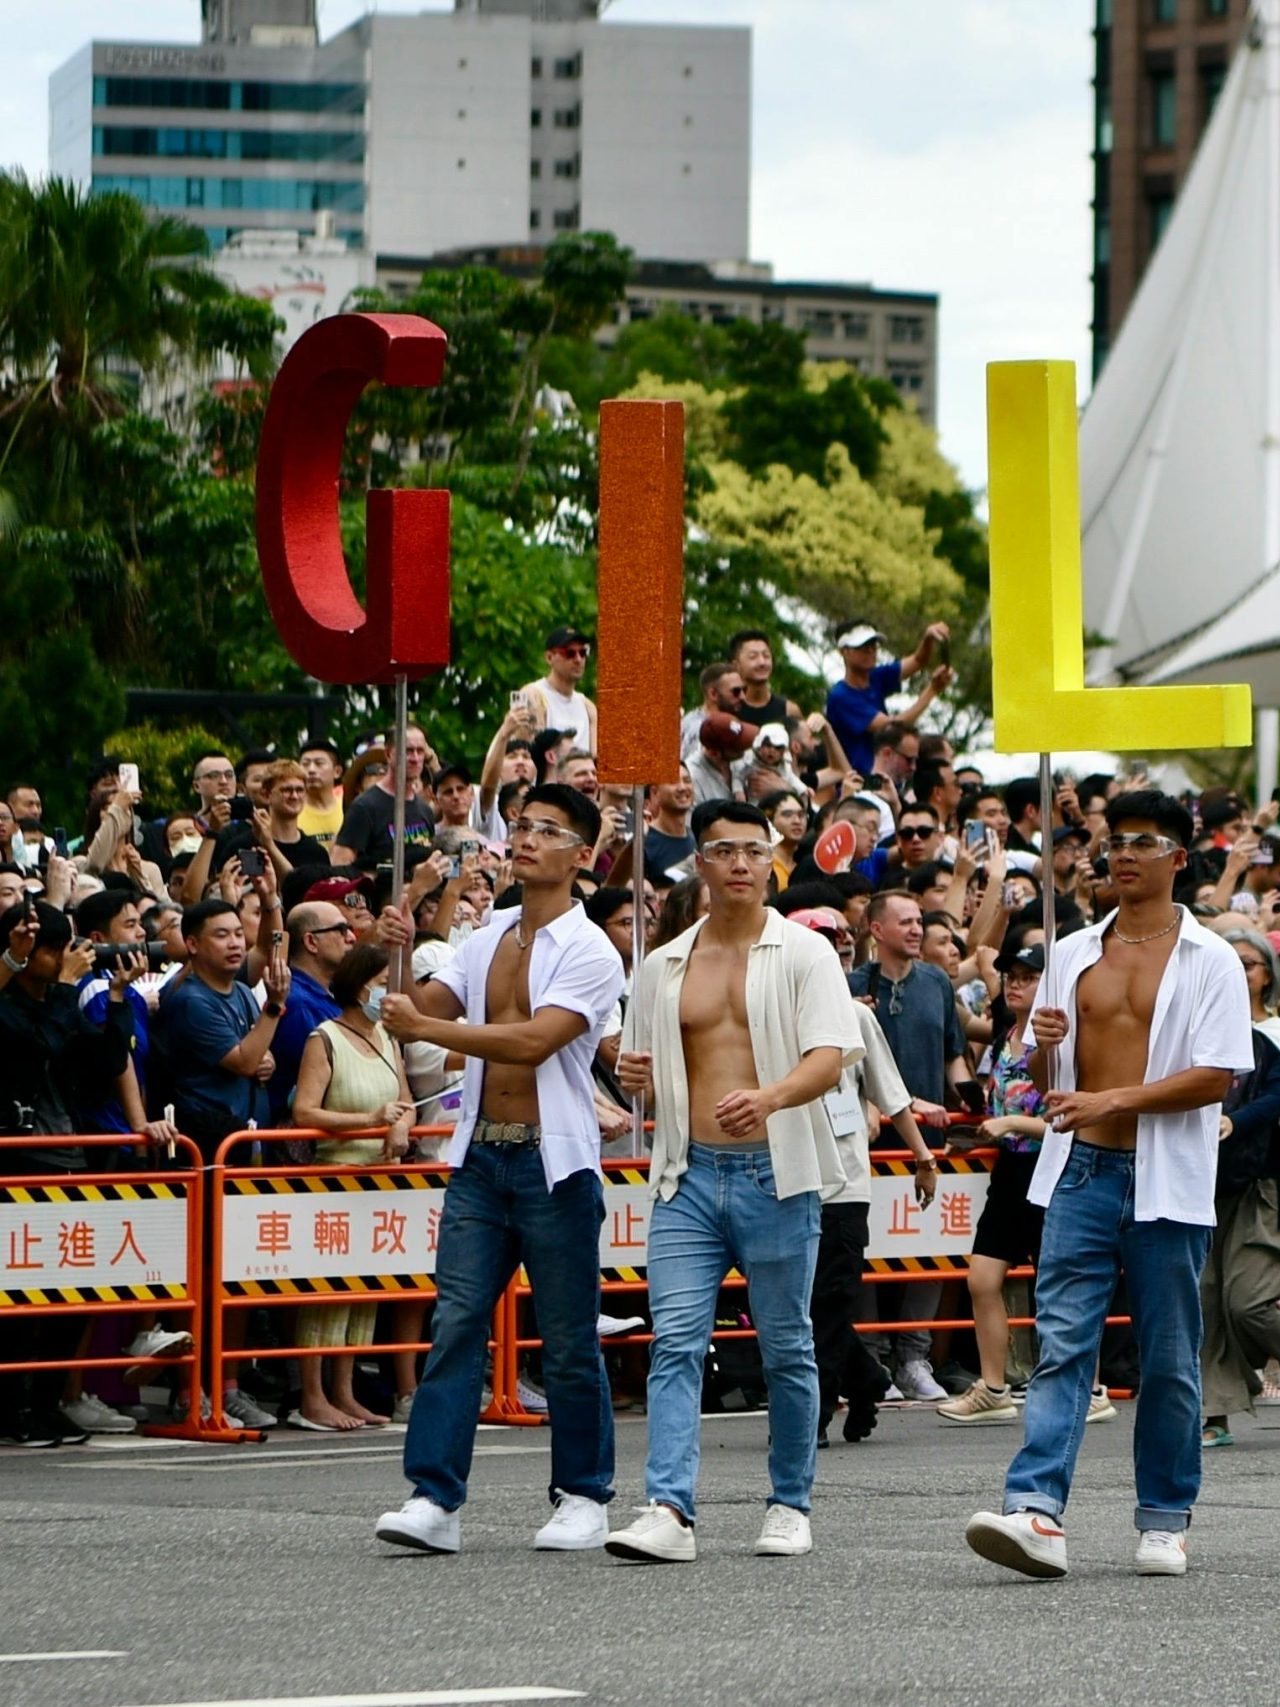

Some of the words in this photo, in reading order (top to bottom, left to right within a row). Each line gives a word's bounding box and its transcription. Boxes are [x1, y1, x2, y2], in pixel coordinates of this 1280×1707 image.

[609, 1203, 646, 1248] 止
[887, 1193, 972, 1236] 止進
[6, 1221, 147, 1269] 止進入
